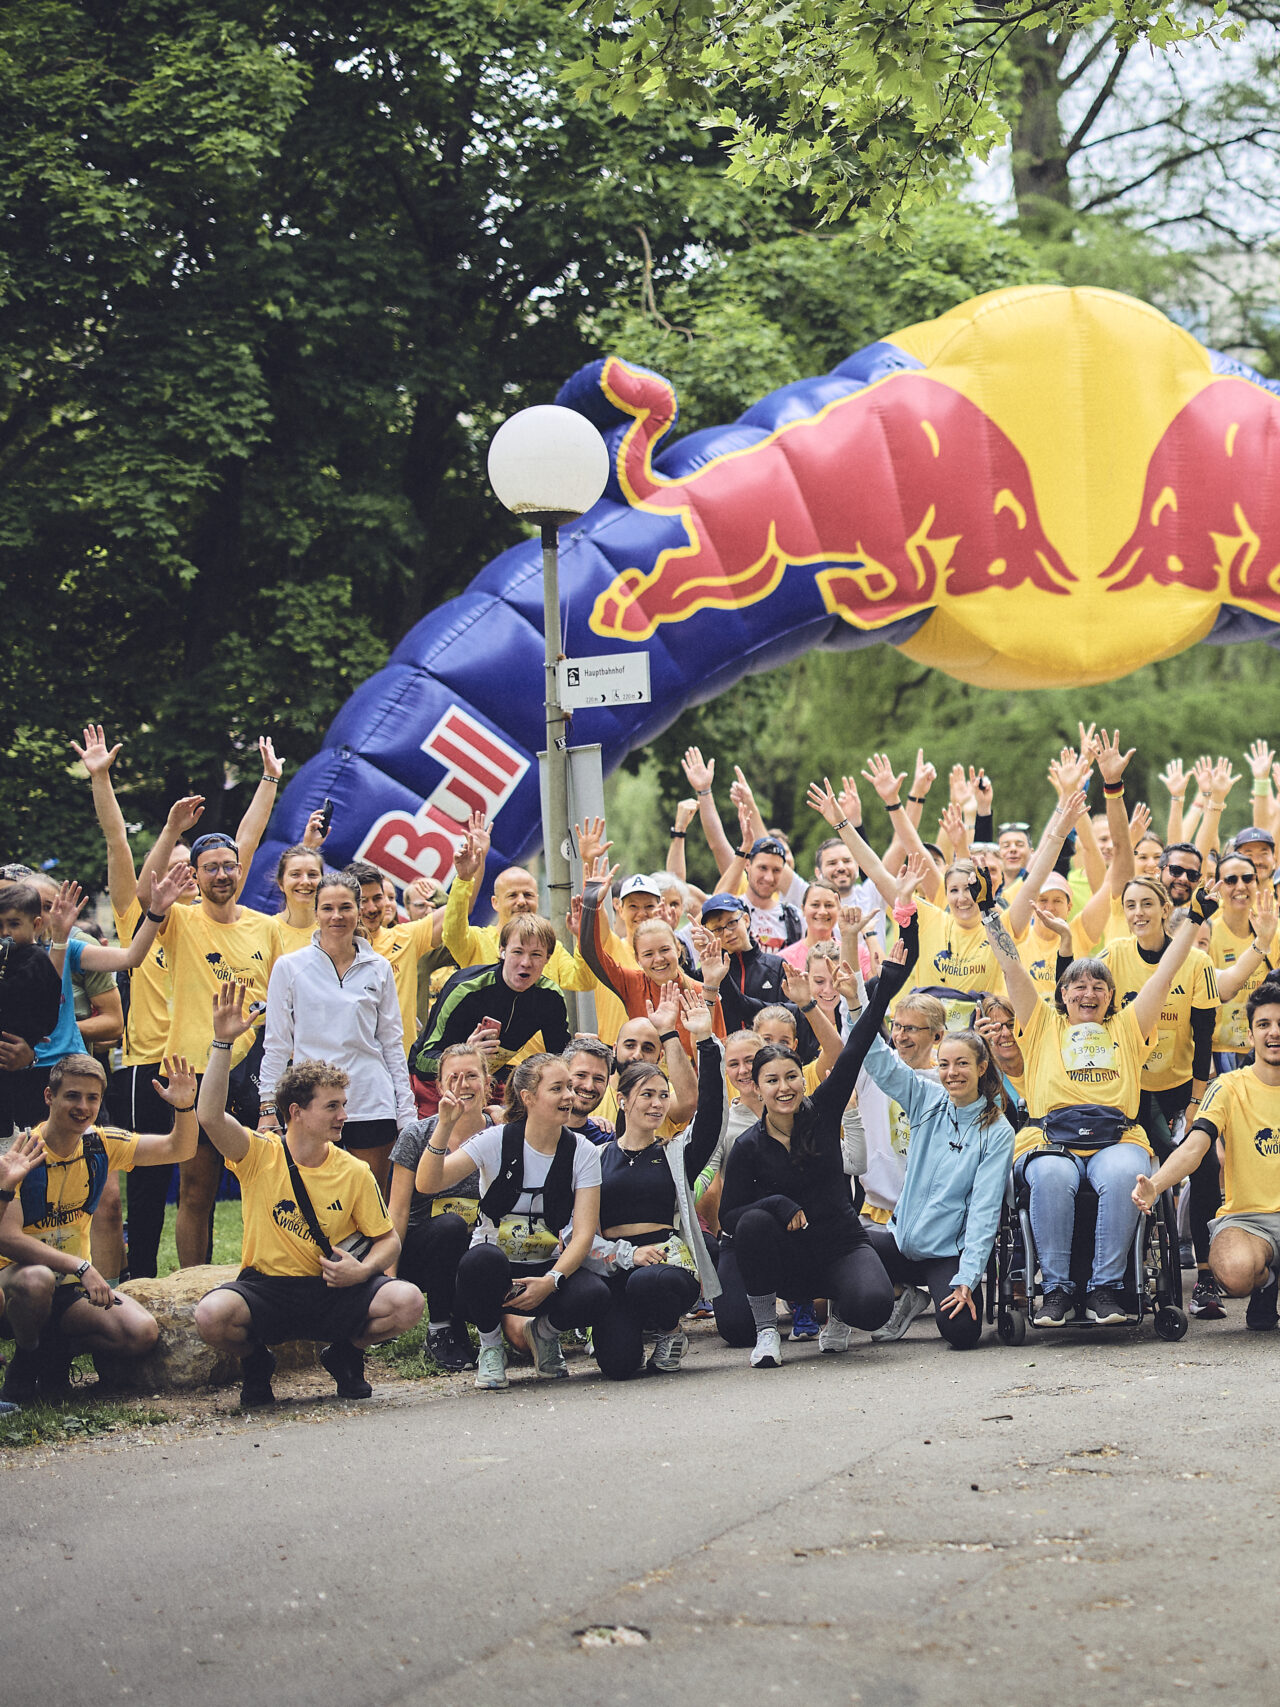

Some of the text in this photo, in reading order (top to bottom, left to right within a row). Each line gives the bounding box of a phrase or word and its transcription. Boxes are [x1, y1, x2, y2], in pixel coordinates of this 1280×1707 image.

[584, 666, 626, 678] Hauptbahnhof
[360, 712, 522, 886] Bull
[632, 876, 645, 887] A
